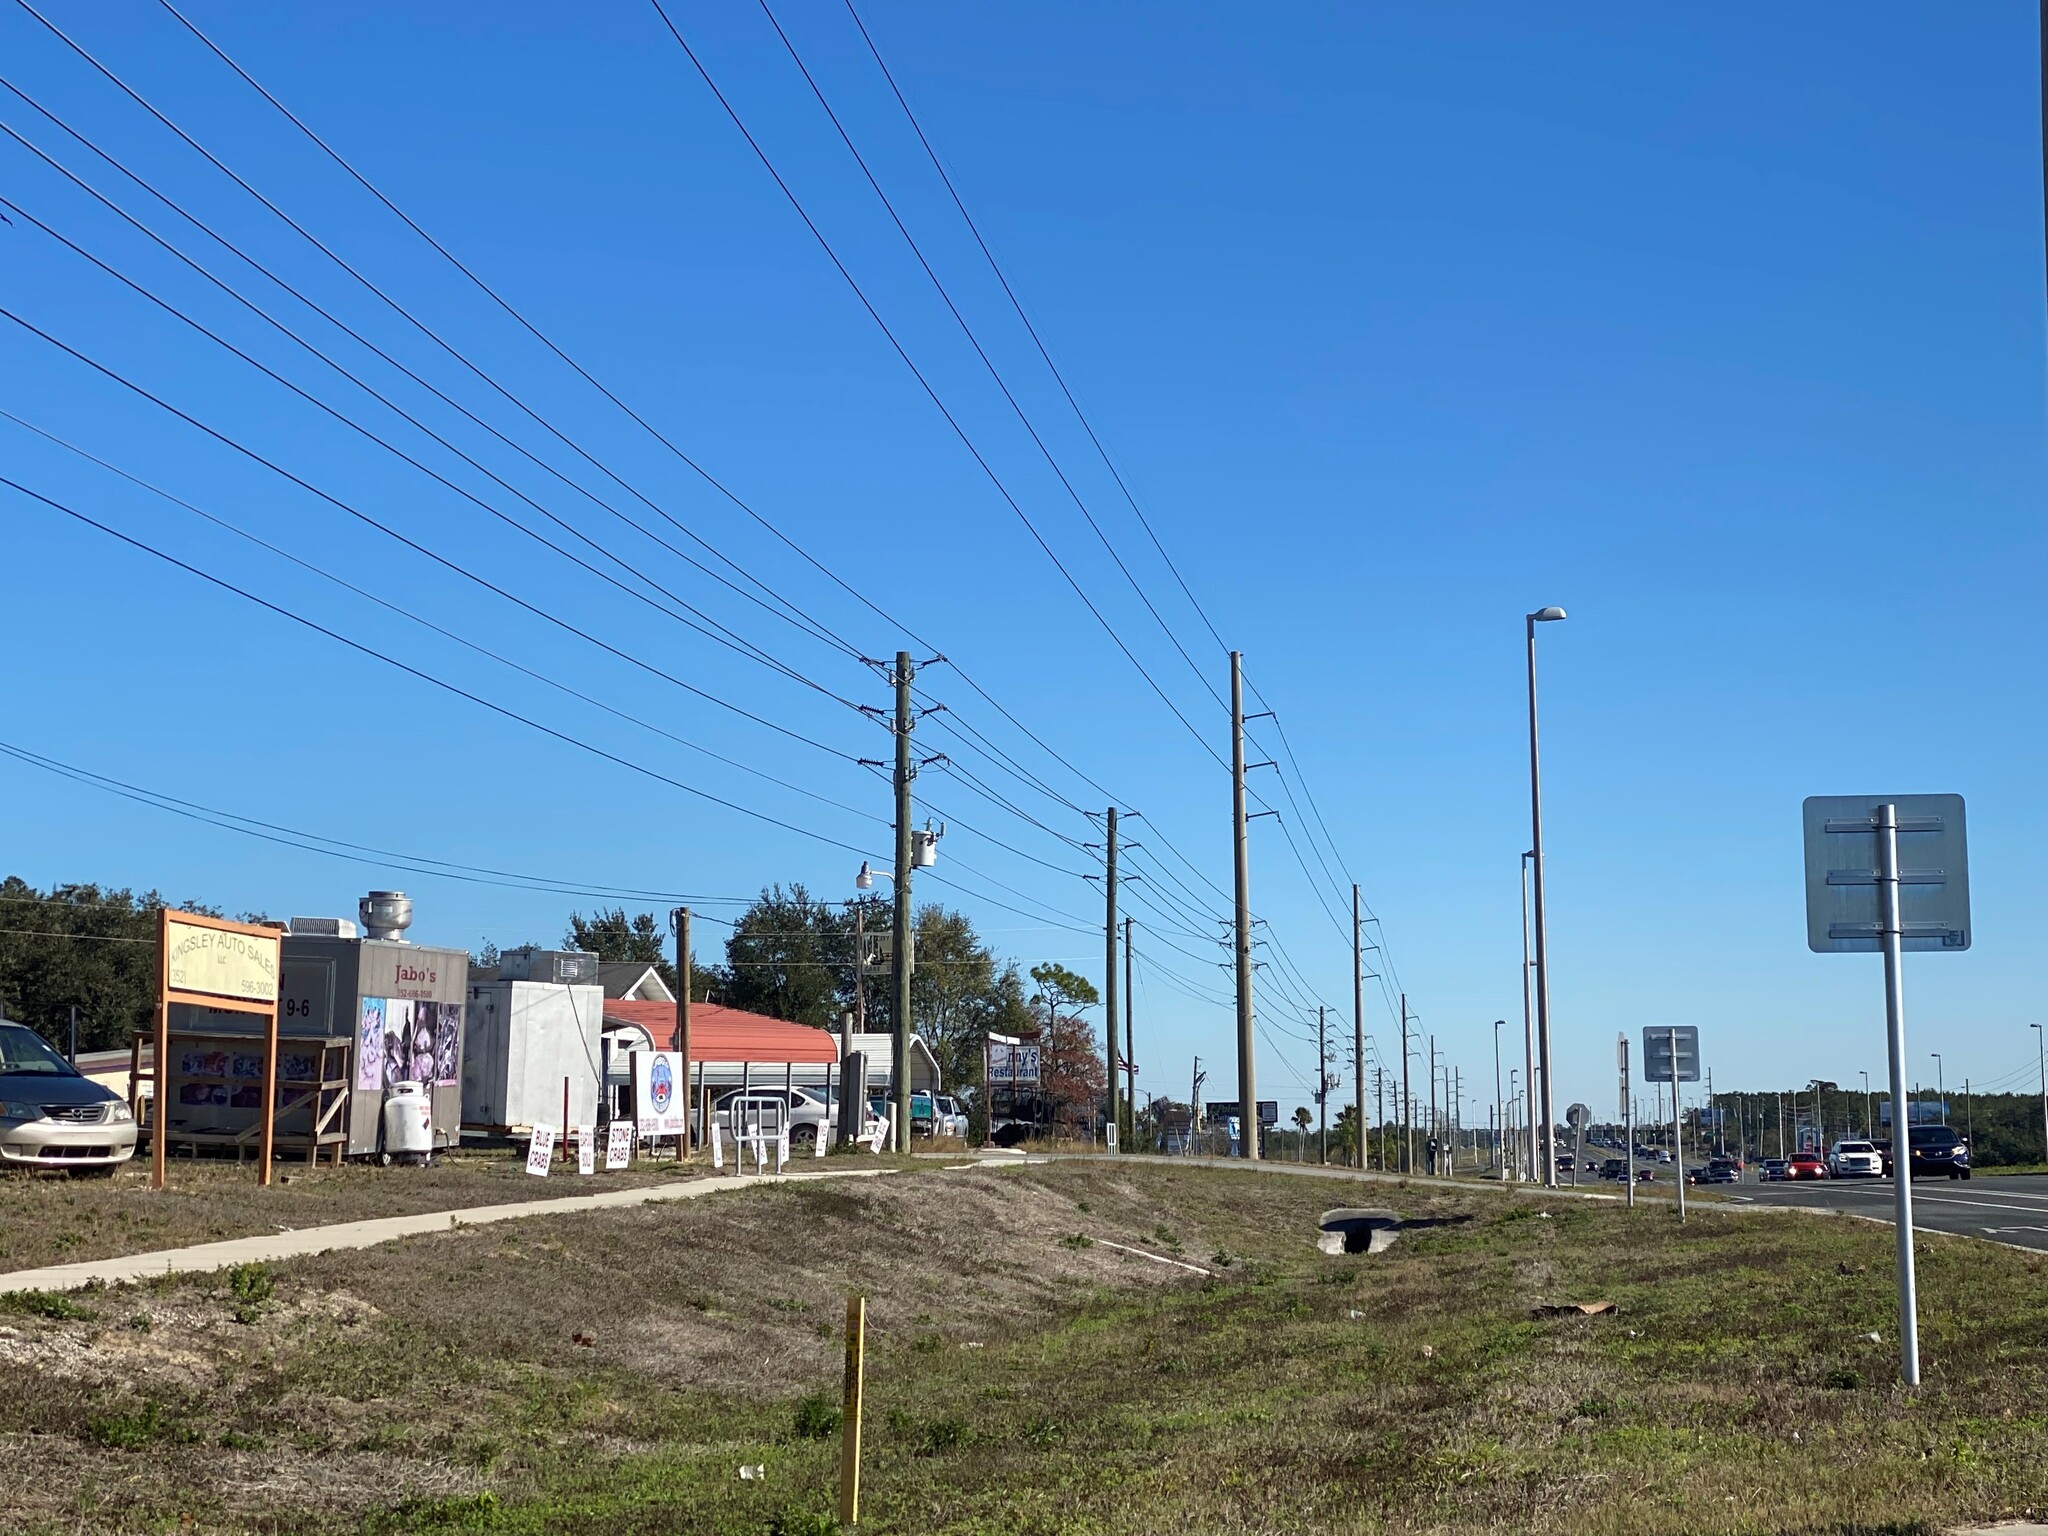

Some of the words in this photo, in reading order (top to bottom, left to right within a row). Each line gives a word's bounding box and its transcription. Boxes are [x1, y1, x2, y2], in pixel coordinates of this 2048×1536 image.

[171, 933, 216, 964] KINGSLEY
[217, 934, 245, 955] AUTO
[247, 944, 276, 980] SALES
[217, 955, 226, 965] LLC
[395, 964, 436, 985] Jabo's
[241, 979, 274, 997] 596-3002
[286, 998, 310, 1018] 9-6
[1008, 1048, 1038, 1066] nny's
[534, 1129, 551, 1148] BLUE
[611, 1127, 630, 1143] STONE
[529, 1150, 549, 1170] CRABS
[608, 1146, 628, 1163] CRABS
